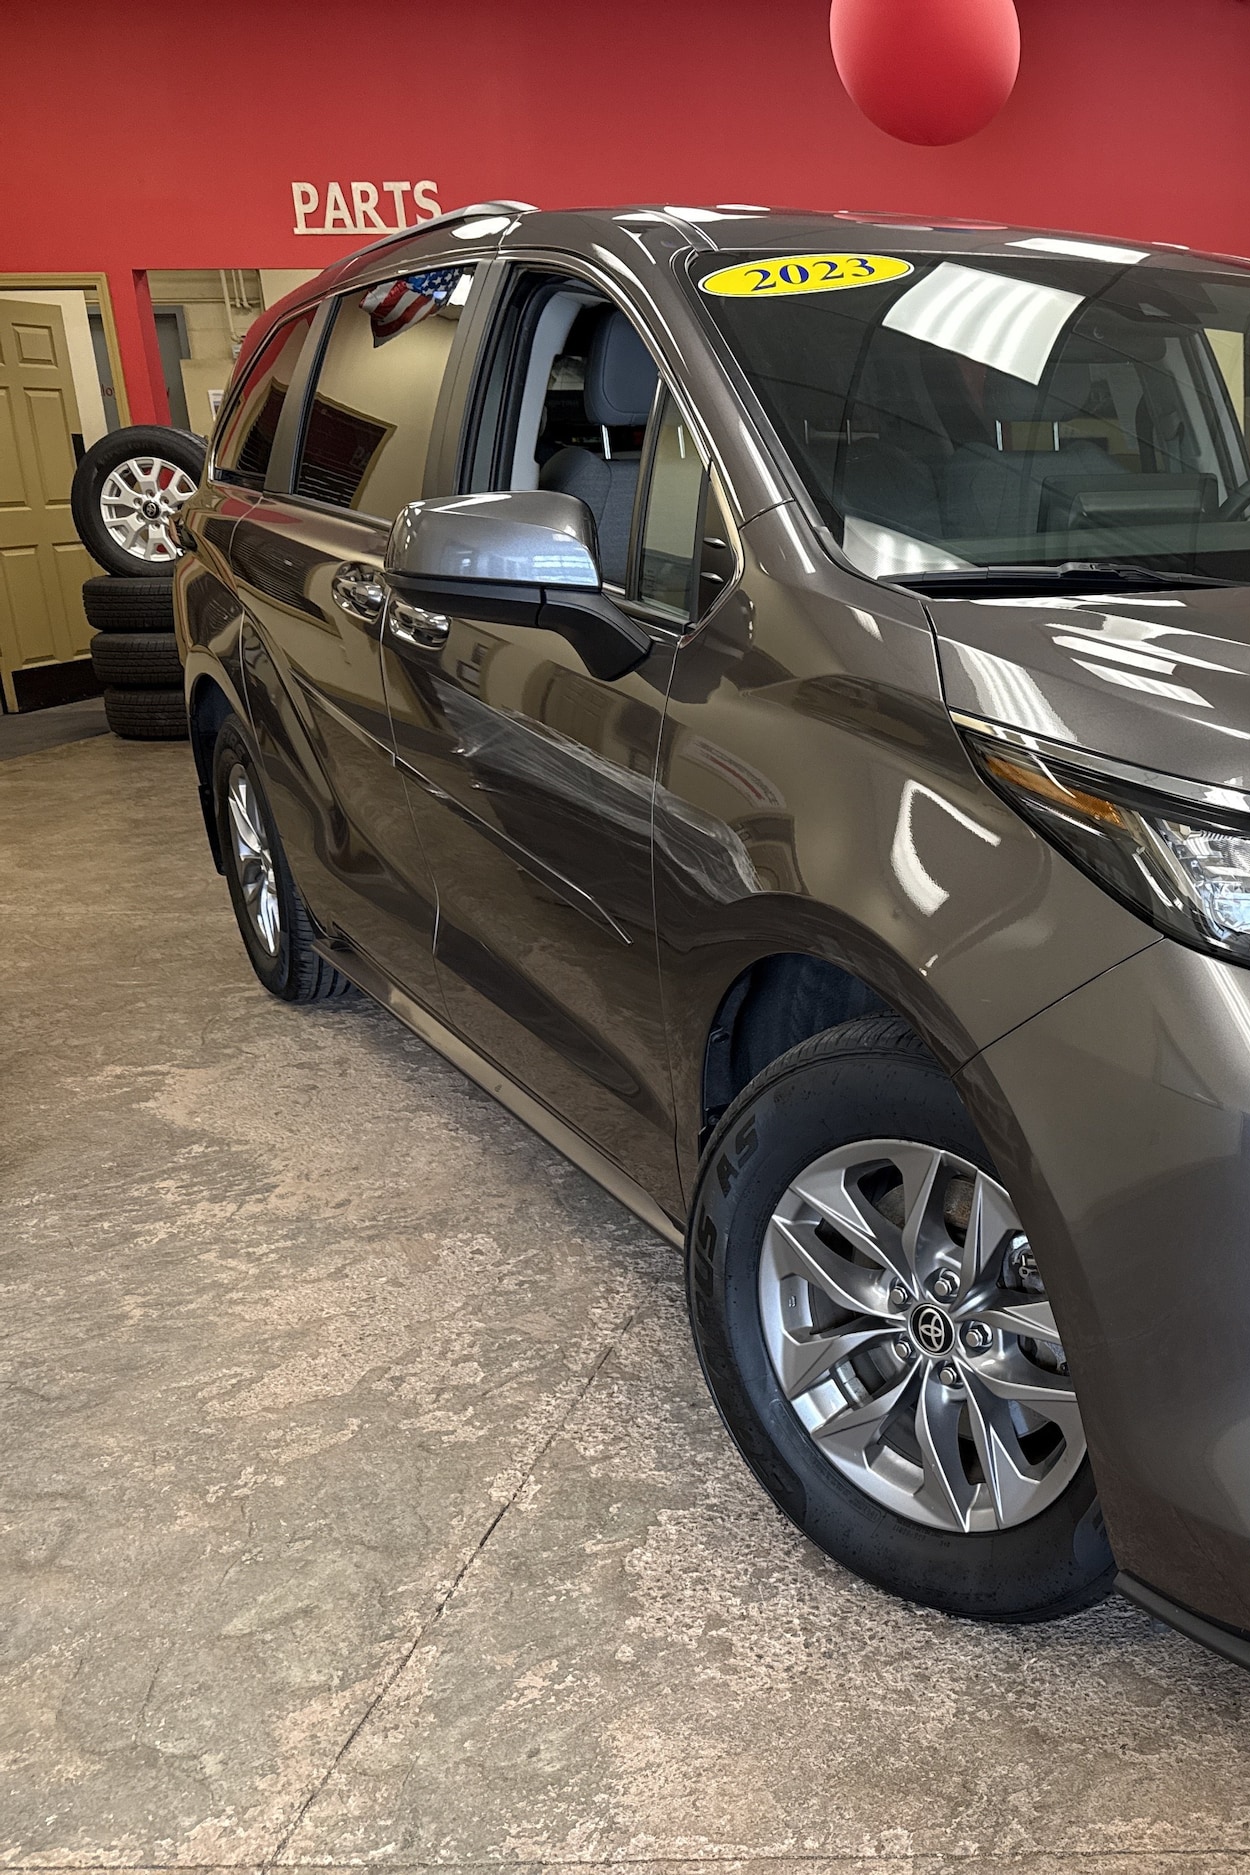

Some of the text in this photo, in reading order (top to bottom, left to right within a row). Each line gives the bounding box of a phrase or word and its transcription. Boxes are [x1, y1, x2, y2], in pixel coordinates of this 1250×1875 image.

[291, 180, 442, 231] PARTS
[744, 258, 875, 292] 2023
[714, 1114, 761, 1199] AS
